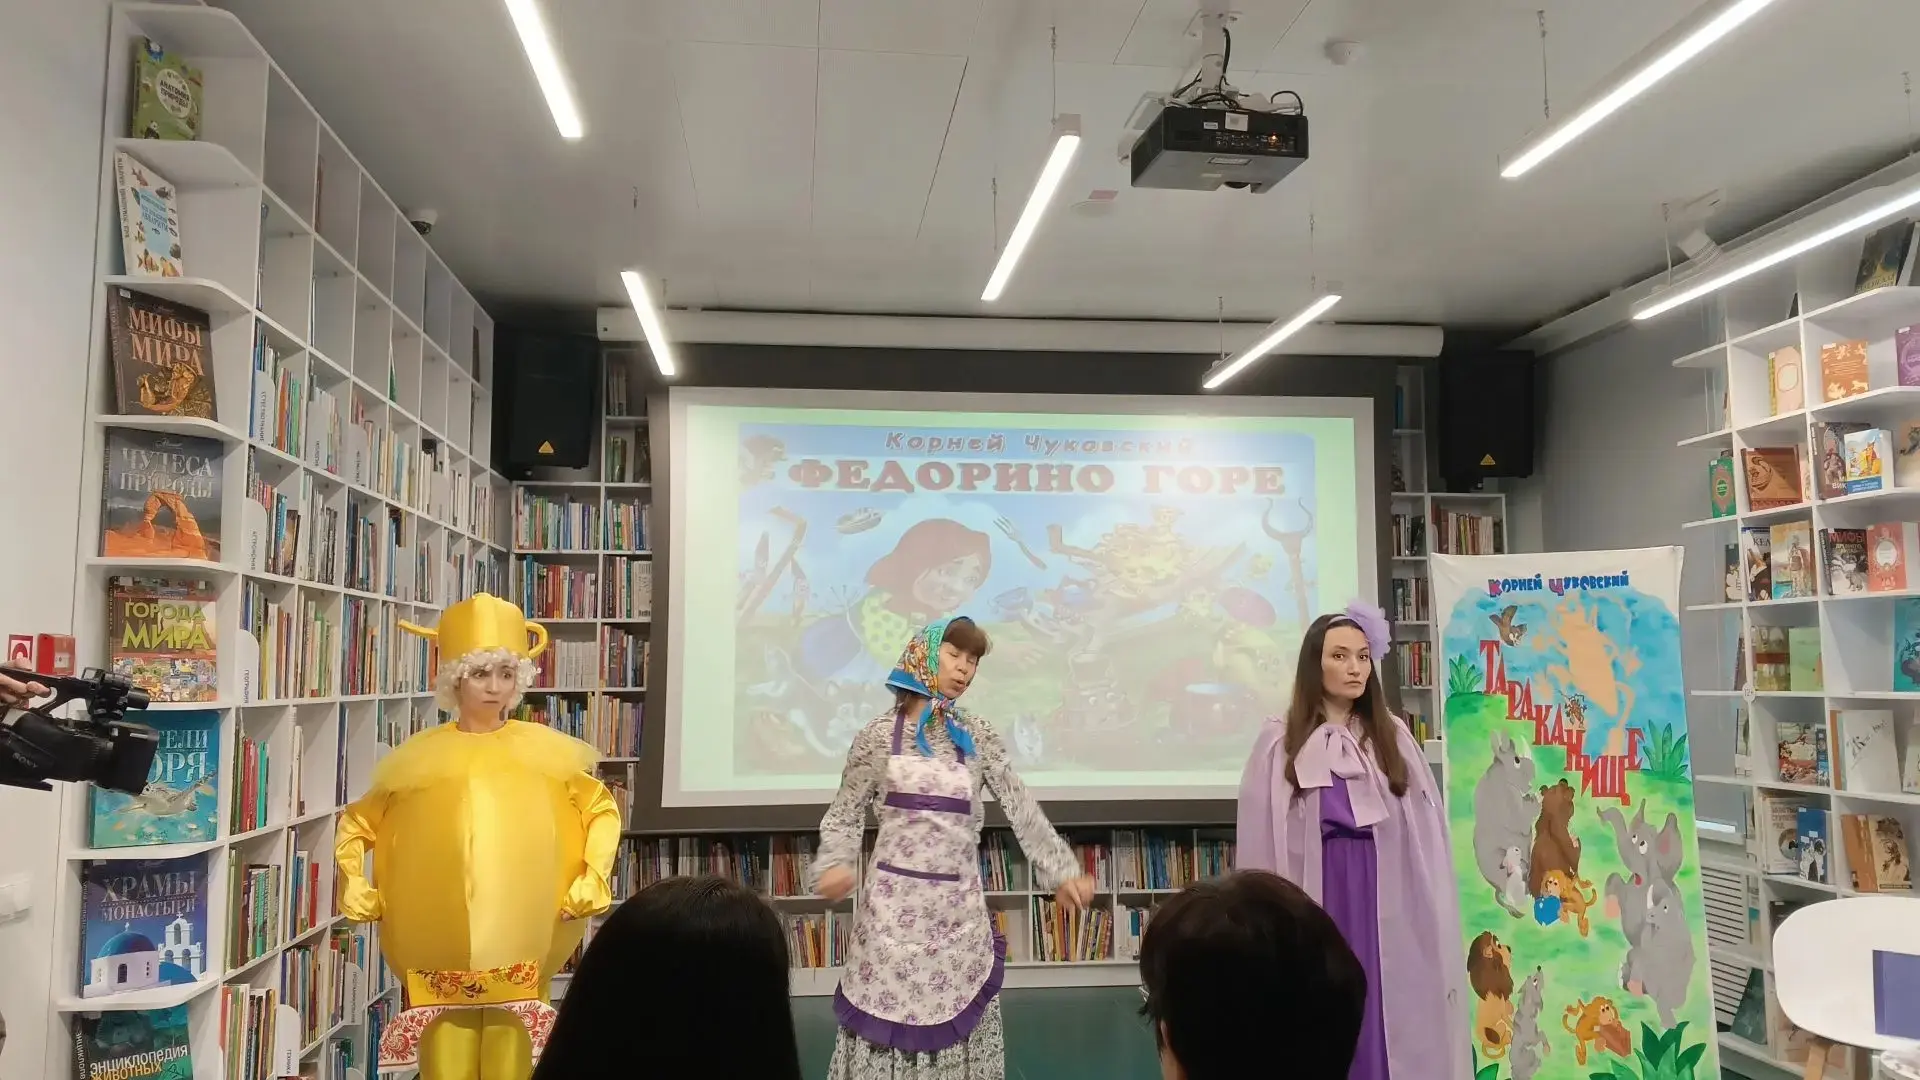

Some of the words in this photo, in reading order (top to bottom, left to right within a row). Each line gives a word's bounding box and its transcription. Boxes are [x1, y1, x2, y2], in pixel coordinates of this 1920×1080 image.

[128, 305, 203, 347] МИФЫ
[130, 332, 205, 377] МИРА
[885, 432, 1006, 455] Корней
[1024, 434, 1194, 456] Чуковский
[121, 447, 214, 477] ЧУДЕСА
[119, 472, 214, 500] ПРИРОДЫ
[788, 458, 1115, 494] ФЕДОРИНО
[1142, 464, 1286, 496] ГОРЕ
[1488, 573, 1542, 597] КОРНЕЙ
[1549, 570, 1630, 597] ЧУКОВСКИЙ
[124, 601, 207, 622] ГОРОДА
[122, 620, 210, 649] МИРА
[101, 870, 199, 903] ХРАМЫ
[100, 898, 196, 922] МОНАСТЫРИ
